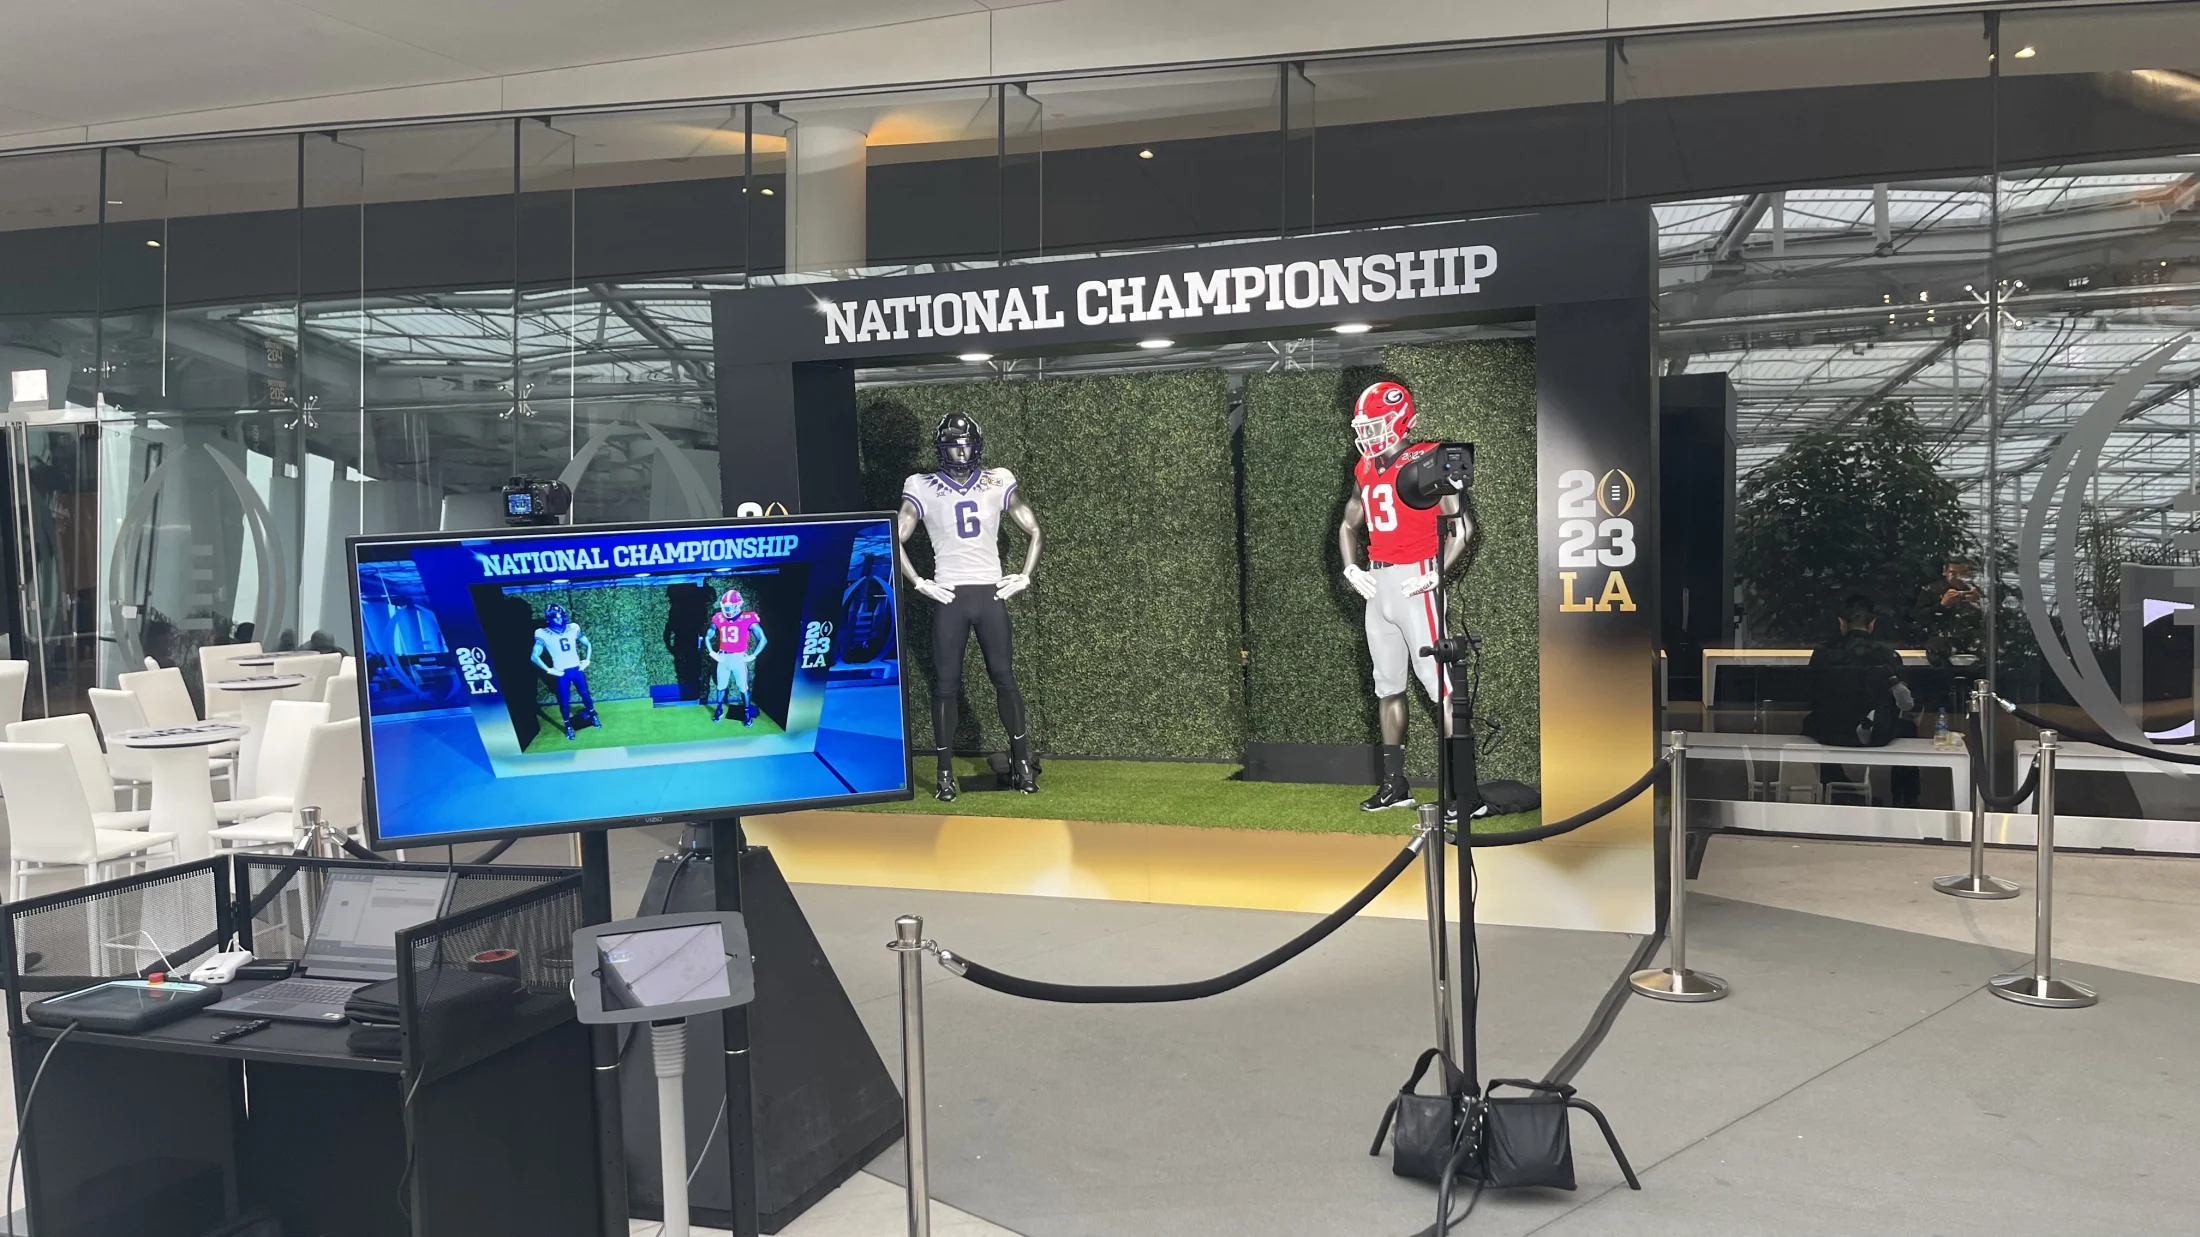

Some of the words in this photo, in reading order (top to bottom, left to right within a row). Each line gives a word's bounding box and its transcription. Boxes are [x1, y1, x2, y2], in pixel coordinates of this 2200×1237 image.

[823, 285, 1064, 344] NATIONAL
[1076, 245, 1498, 326] CHAMPIONSHIP
[954, 500, 981, 539] 6
[1361, 484, 1398, 532] 13
[482, 547, 609, 577] NATIONAL
[613, 534, 799, 568] CHAMPIONSHIP
[1558, 517, 1636, 567] 23
[1559, 570, 1637, 612] LA
[720, 626, 739, 643] 13
[803, 637, 831, 654] 23
[462, 663, 492, 680] 23
[801, 654, 827, 668] LA
[467, 680, 498, 694] LA
